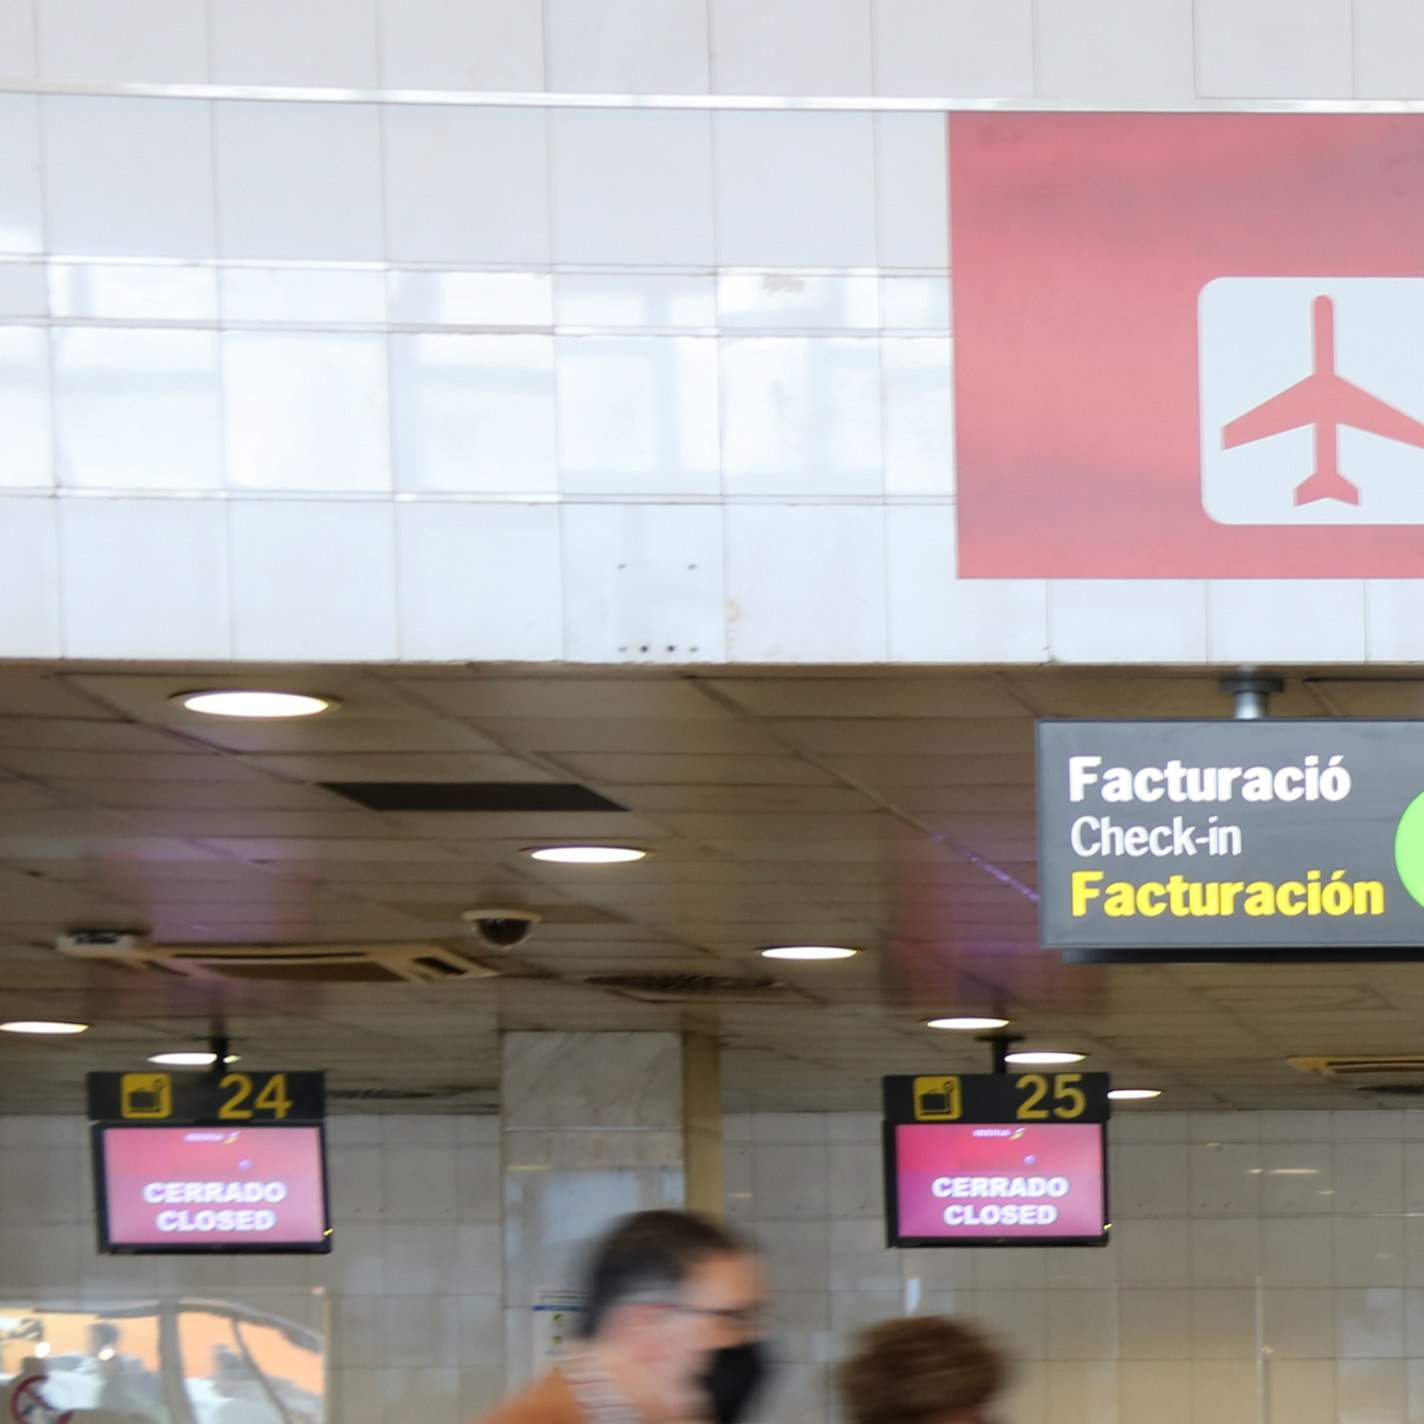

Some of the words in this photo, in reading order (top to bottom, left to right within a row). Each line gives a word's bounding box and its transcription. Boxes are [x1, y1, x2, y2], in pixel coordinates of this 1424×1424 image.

[1069, 755, 1352, 804] Facturació
[1071, 815, 1242, 858] Check-in
[1071, 869, 1385, 918] Facturación
[218, 1073, 292, 1119] 24
[1015, 1074, 1087, 1119] 25
[143, 1181, 288, 1204] CERRADO
[931, 1176, 1070, 1198] CERRADO
[155, 1209, 277, 1232] CLOSED
[942, 1204, 1059, 1226] CLOSED
